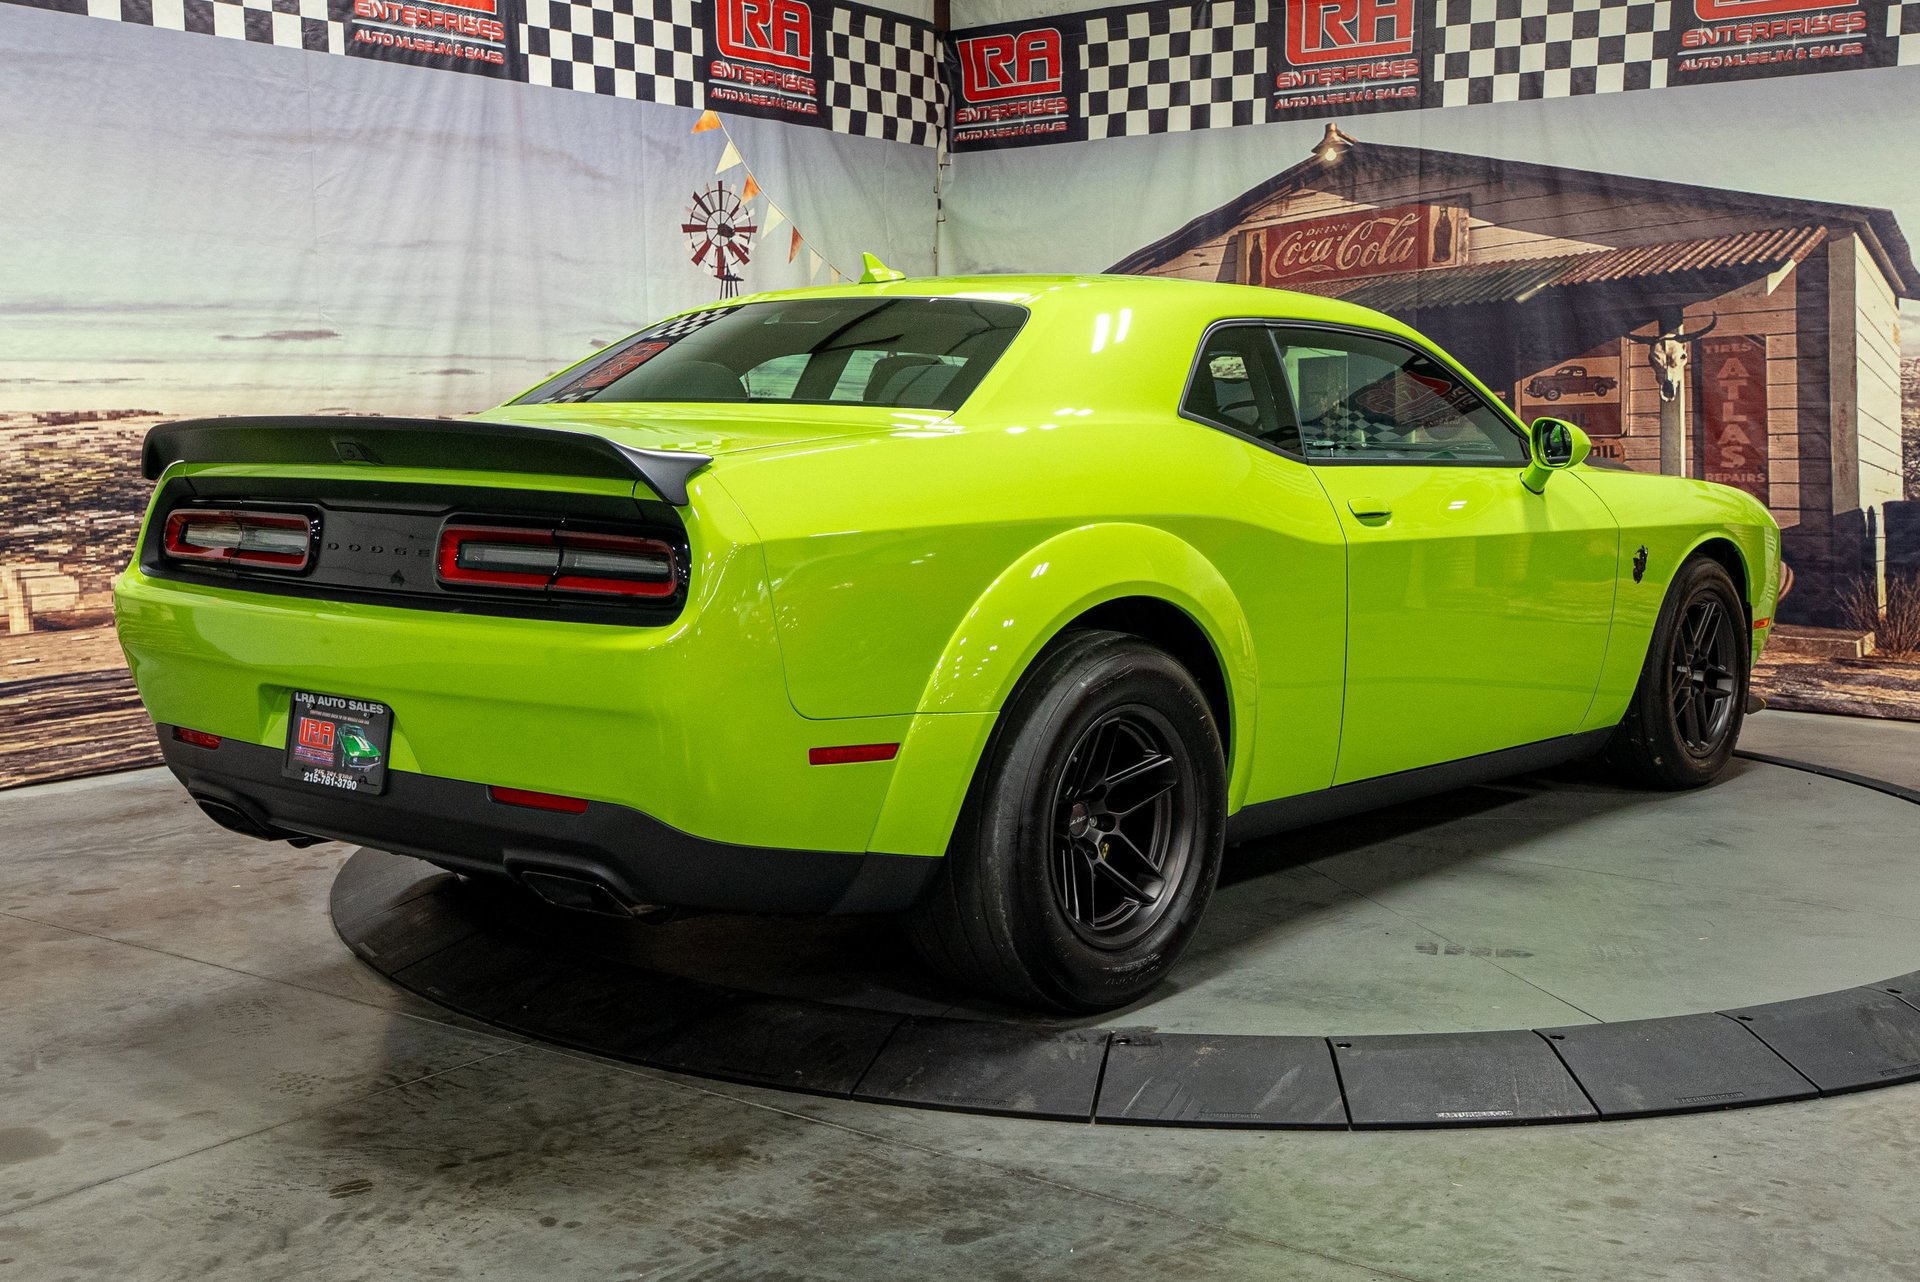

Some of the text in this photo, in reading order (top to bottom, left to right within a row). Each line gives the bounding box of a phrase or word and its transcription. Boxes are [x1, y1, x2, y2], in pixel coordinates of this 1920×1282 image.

[354, 0, 505, 41] ENTERPRISES
[1682, 11, 1867, 47] ENTERPRISES
[354, 29, 505, 64] AUTO MUSEUM & SALES
[715, 0, 812, 73] LRA
[956, 27, 1062, 103] LRA
[1679, 42, 1863, 72] AUTO MUSEUM & SALES
[710, 60, 816, 95] ENTERPRISES
[1276, 58, 1419, 89] ENTERPRISES
[710, 87, 738, 100] AUTO
[786, 100, 818, 114] SALES
[956, 97, 1068, 123] ENTERPRISES
[1275, 96, 1309, 109] AUTO
[1311, 90, 1364, 106] MUSEUM
[1375, 86, 1417, 100] SALES
[954, 130, 983, 141] AUTO
[984, 126, 1024, 139] MUSEUM
[1034, 121, 1068, 133] SALES
[1306, 223, 1350, 237] DRINK
[1703, 343, 1751, 354] TIRES
[1717, 357, 1751, 468] ATLAS
[1705, 472, 1766, 483] REPAIRS
[328, 543, 430, 558] DODGE
[295, 692, 384, 714] LRA AUTO SALES
[299, 716, 335, 751] LRA
[304, 771, 357, 790] 215-781-3790
